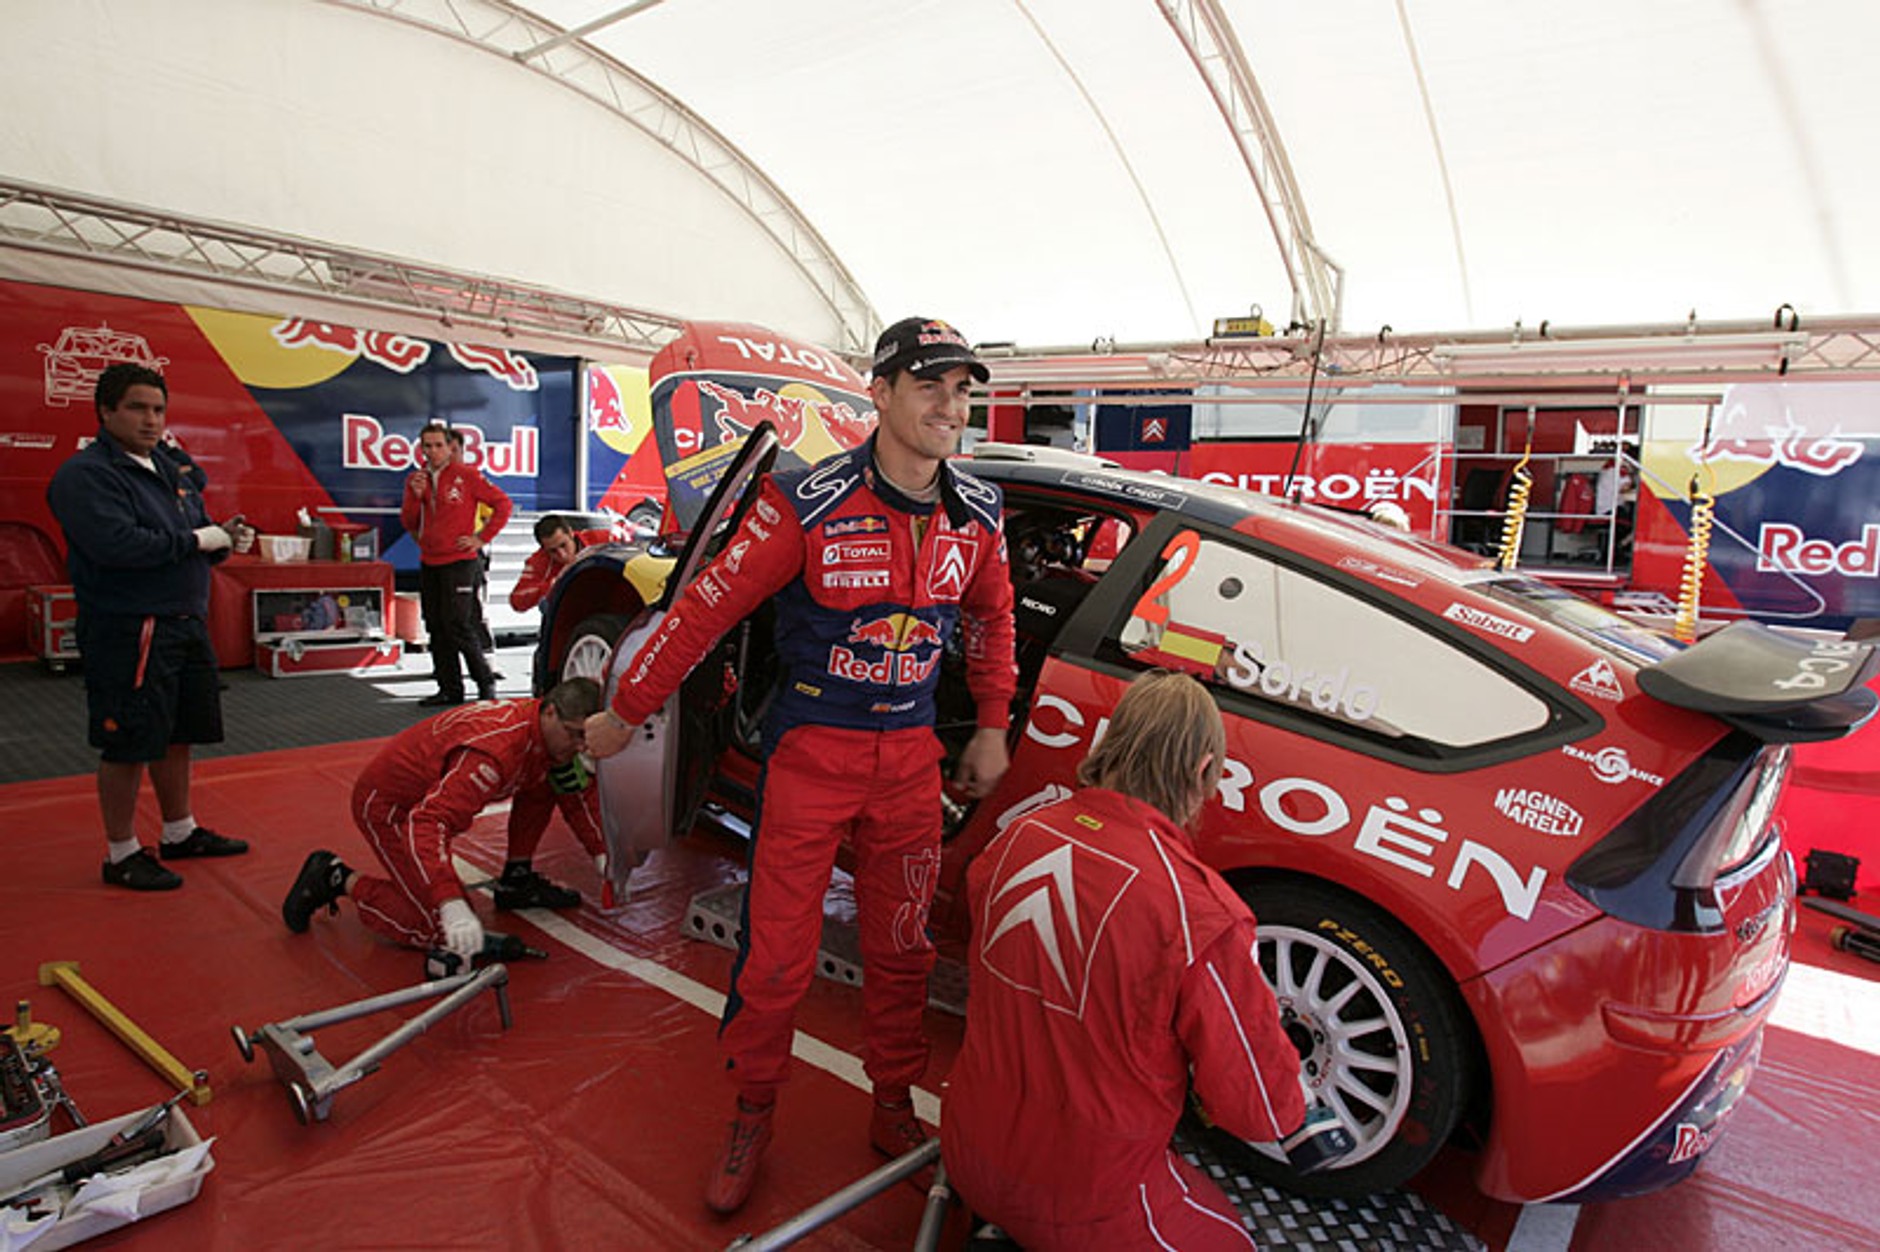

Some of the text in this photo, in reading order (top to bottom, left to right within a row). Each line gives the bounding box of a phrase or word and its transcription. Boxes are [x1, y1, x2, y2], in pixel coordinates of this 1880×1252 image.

[716, 335, 848, 382] TOTAL
[450, 423, 539, 477] Bull
[841, 546, 888, 559] TOTAL
[1757, 523, 1880, 577] Red
[1132, 529, 1200, 627] 2
[828, 644, 942, 686] Red Bu
[1226, 640, 1379, 721] Sordo
[1026, 694, 1548, 922] CIROËN
